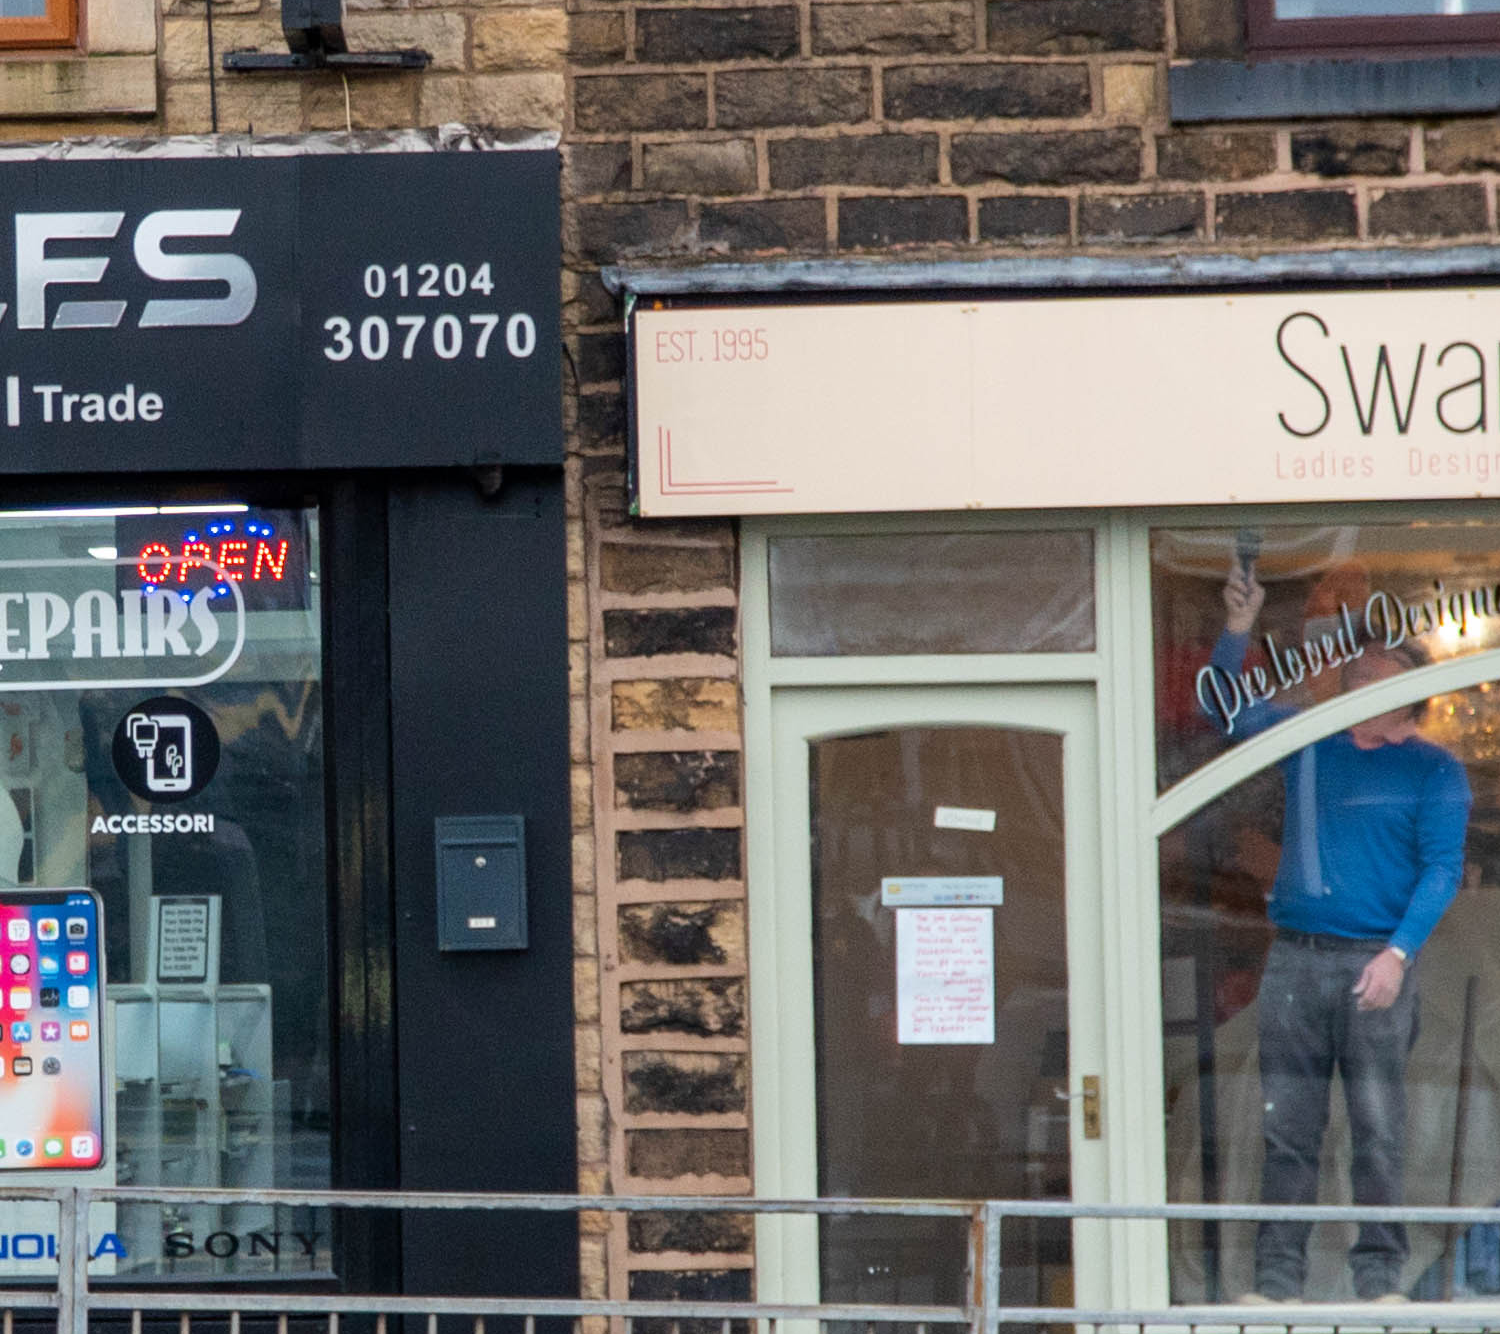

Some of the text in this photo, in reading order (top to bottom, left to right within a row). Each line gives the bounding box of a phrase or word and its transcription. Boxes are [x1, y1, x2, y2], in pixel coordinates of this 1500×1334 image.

[363, 263, 496, 300] 01204
[322, 313, 538, 363] 307070
[656, 327, 770, 363] EST. 1995
[33, 383, 165, 424] Trade
[1275, 449, 1375, 481] Ladies
[137, 540, 289, 584] OPEN
[163, 1231, 323, 1259] SONY
